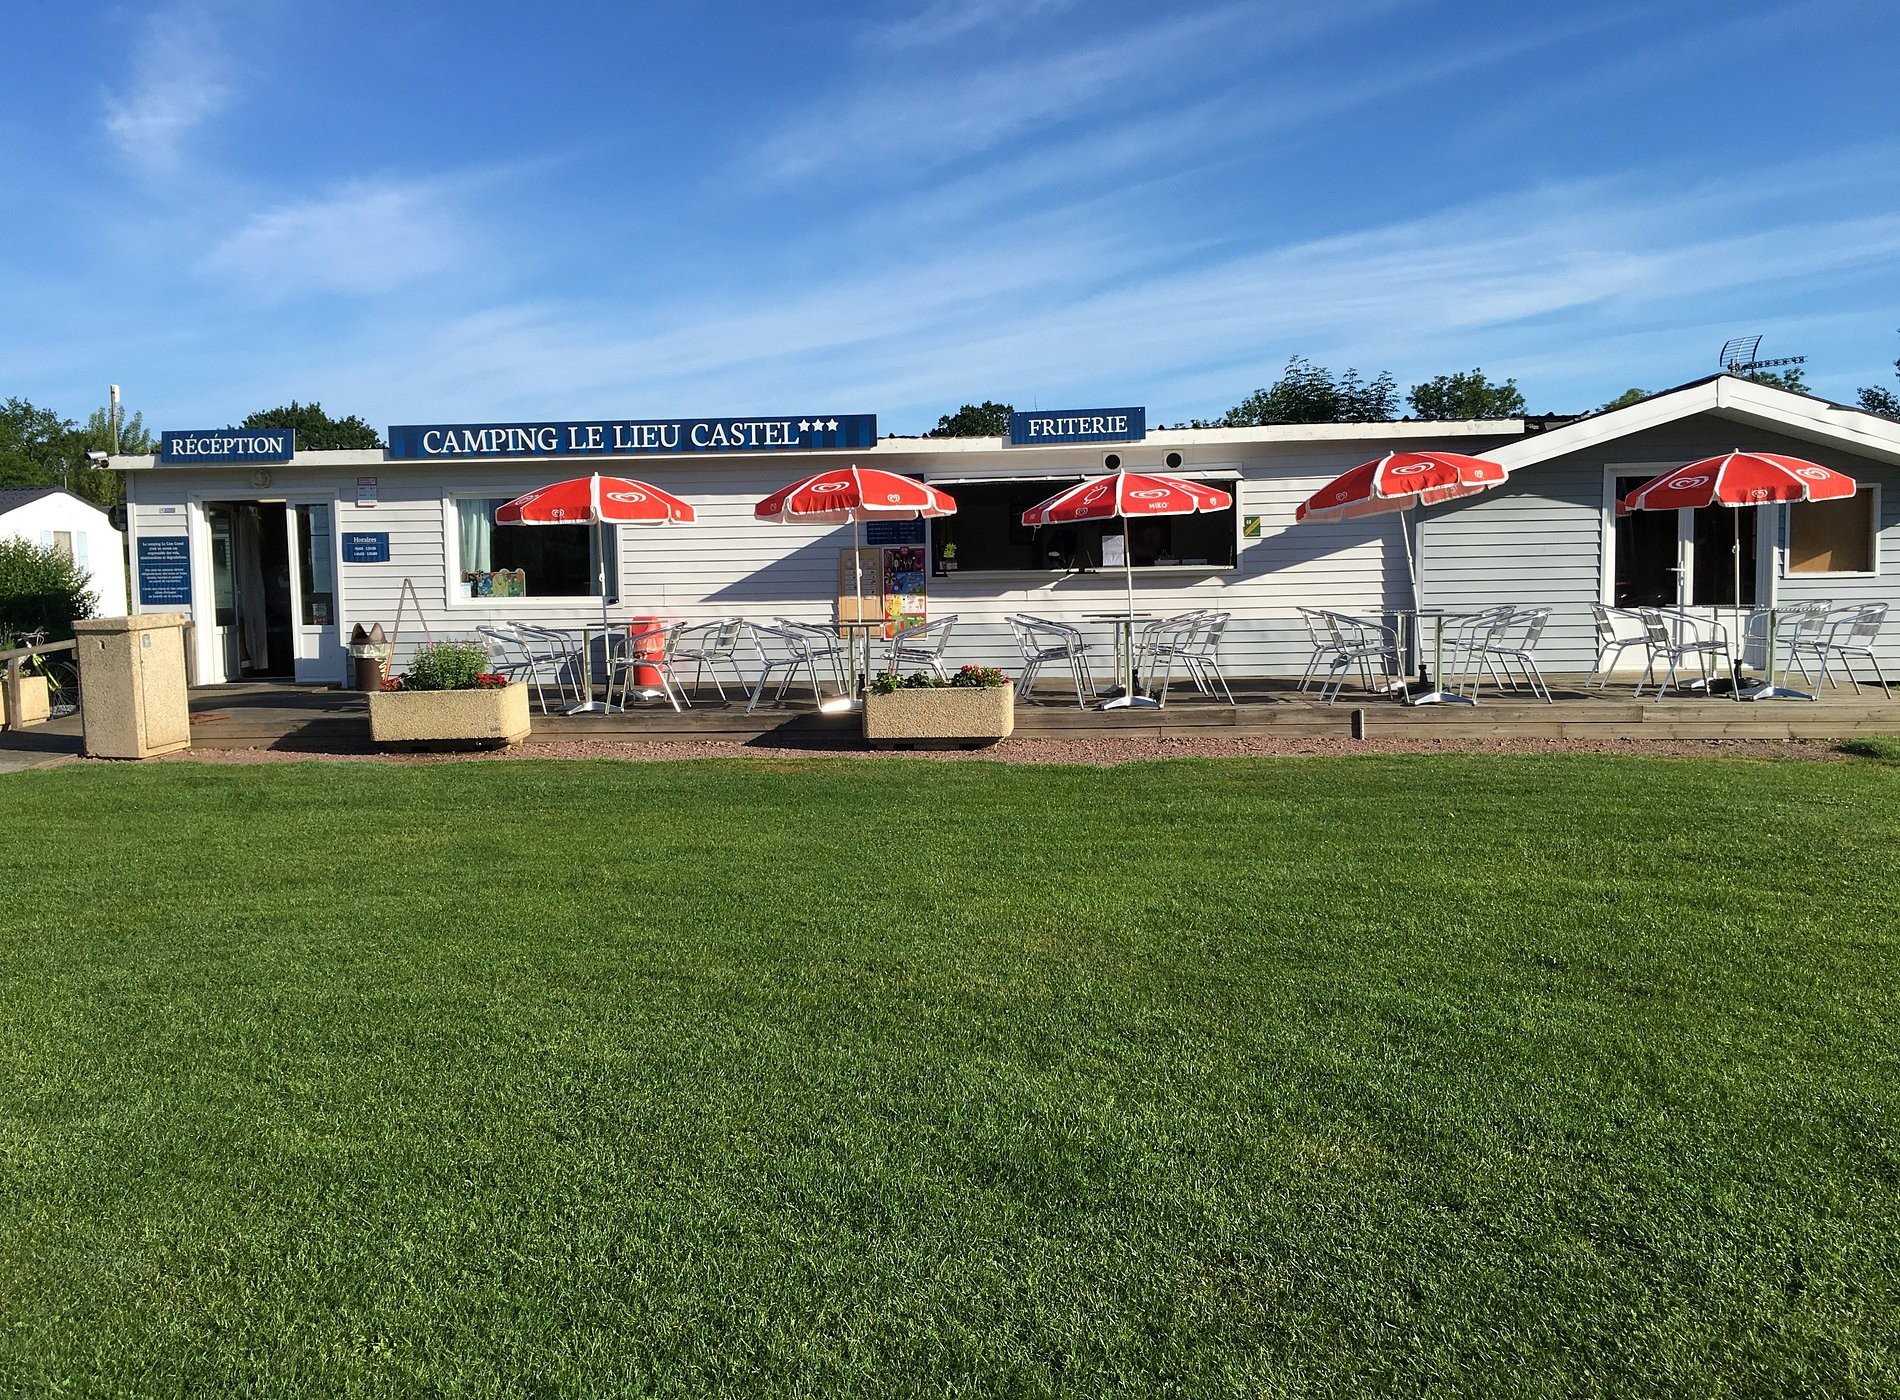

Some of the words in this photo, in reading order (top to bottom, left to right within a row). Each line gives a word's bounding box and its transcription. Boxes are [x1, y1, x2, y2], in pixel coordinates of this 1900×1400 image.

[1028, 415, 1128, 436] FRITERIE
[171, 433, 284, 455] RÉCÉPTION
[423, 427, 559, 454] CAMPING
[567, 426, 605, 450] LE
[613, 424, 681, 448] LIEU
[691, 422, 800, 447] CASTEL
[1148, 501, 1168, 509] MIKO
